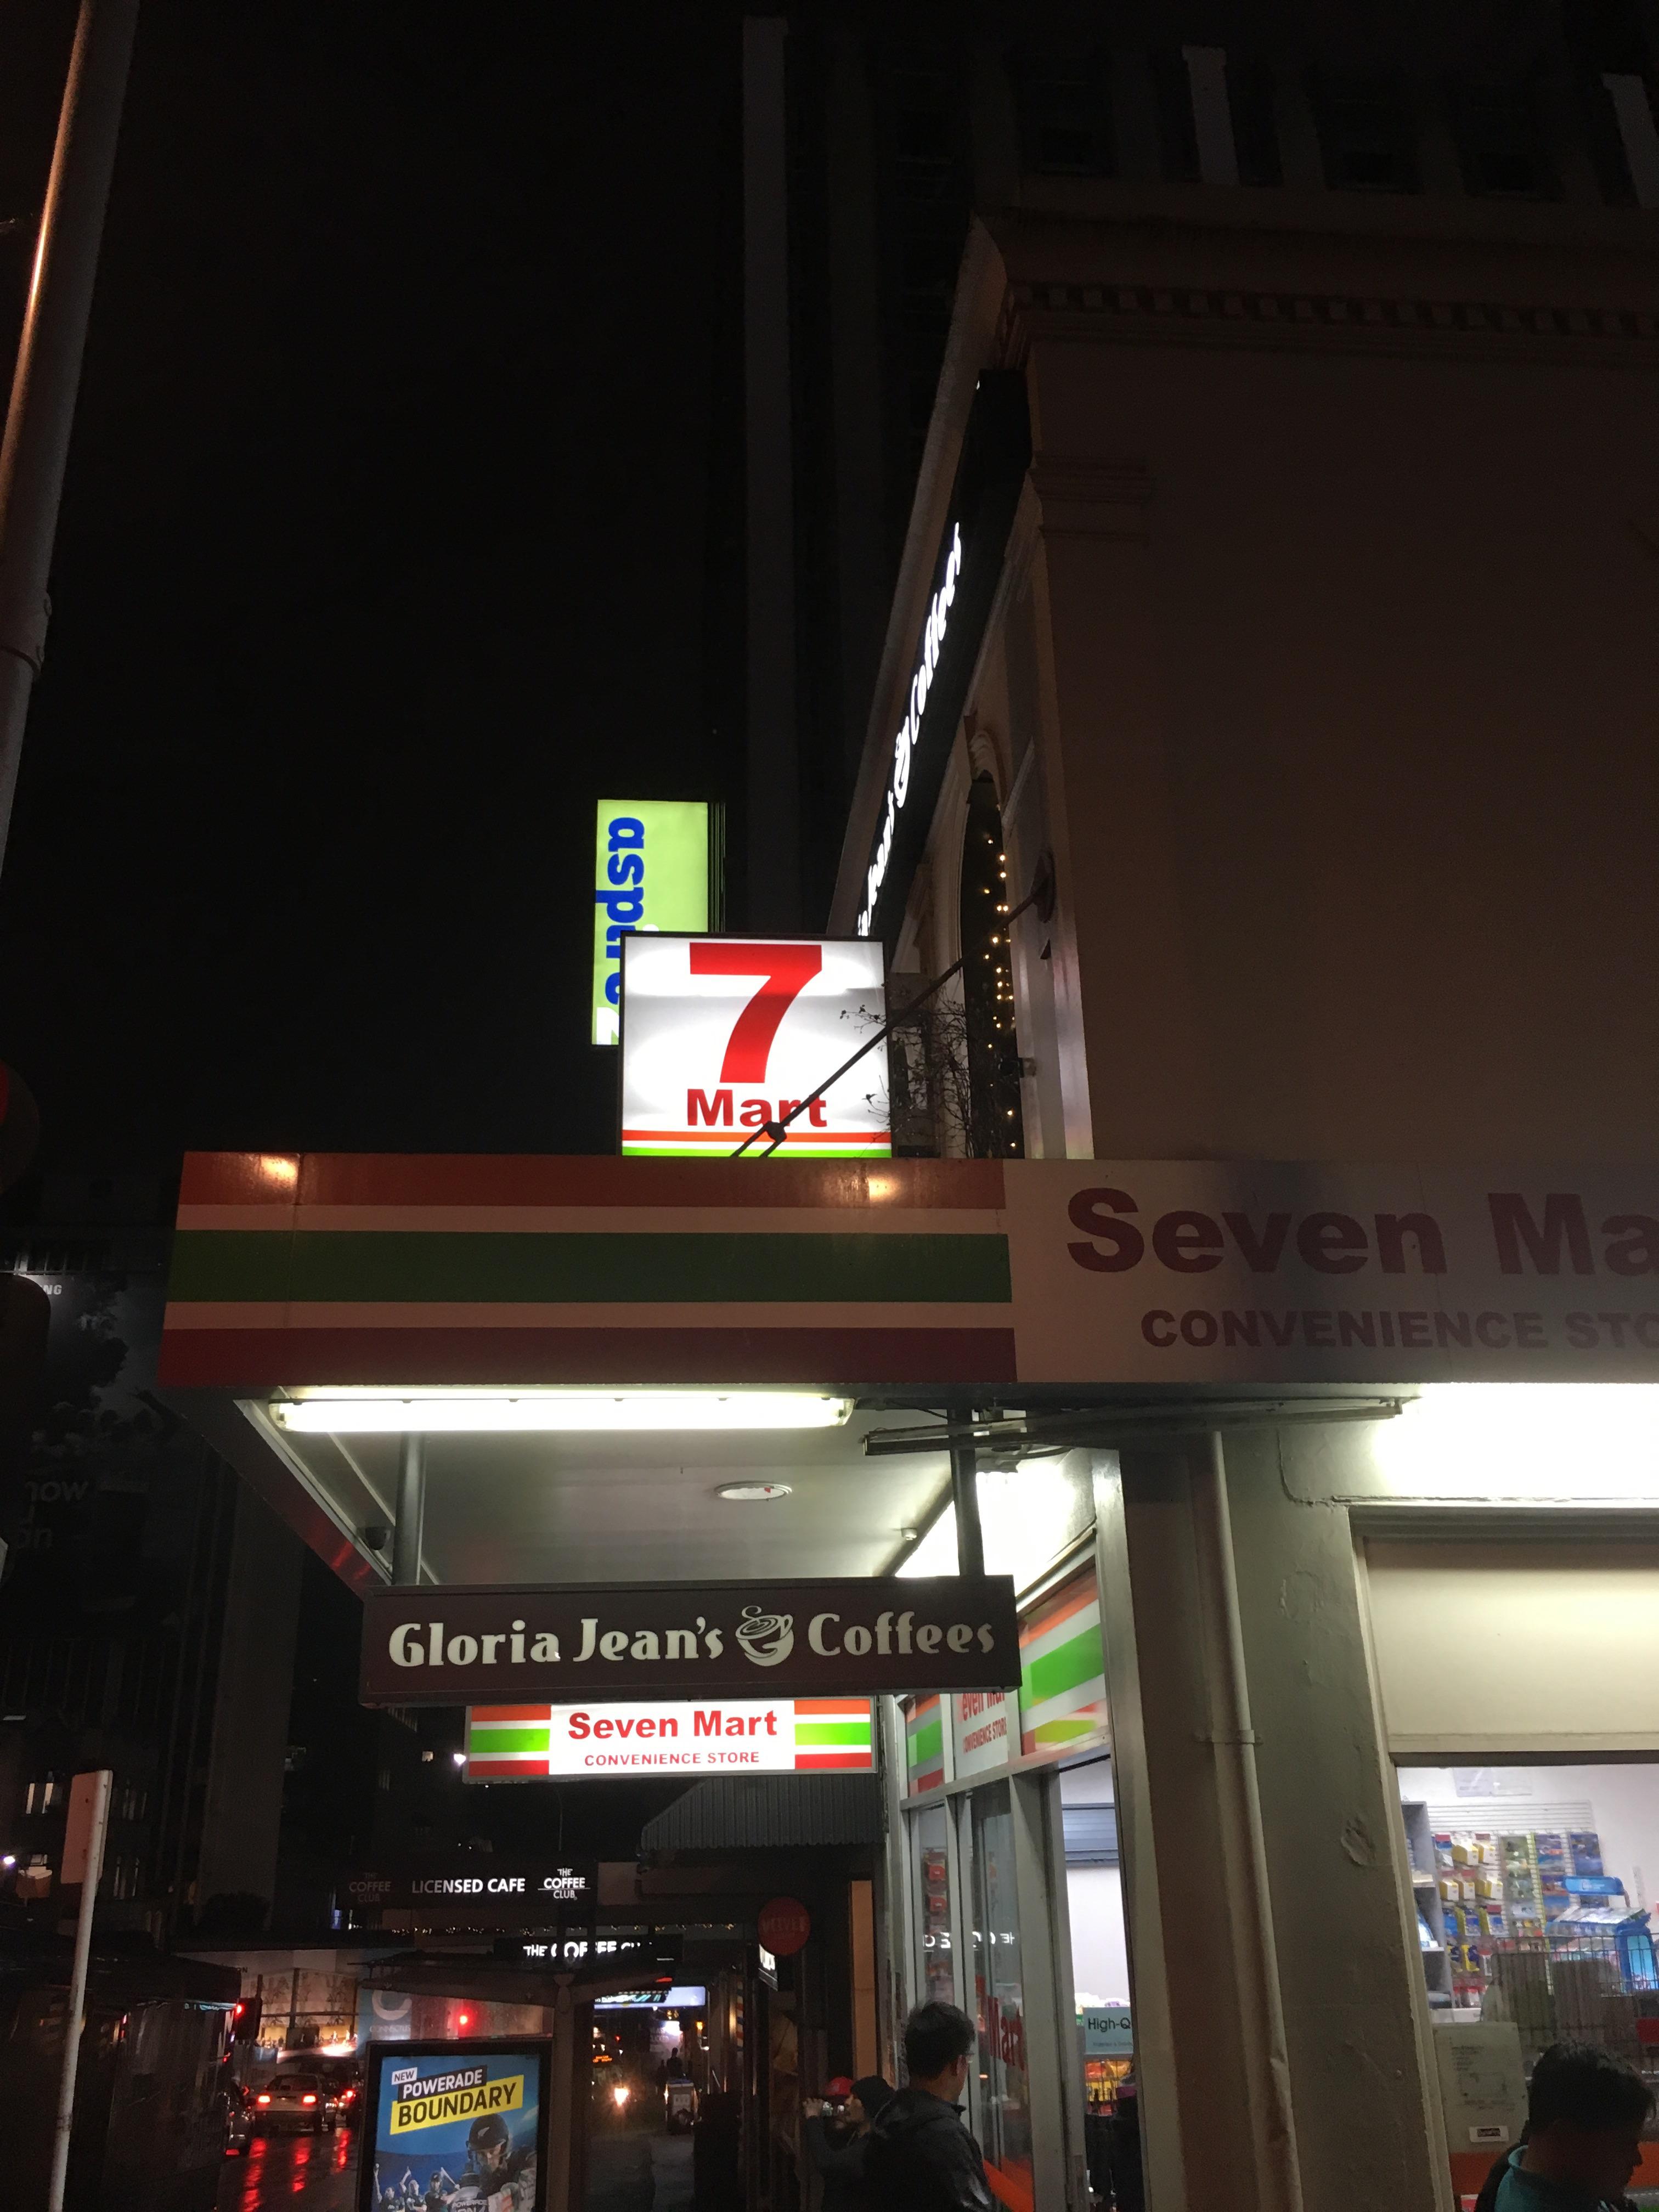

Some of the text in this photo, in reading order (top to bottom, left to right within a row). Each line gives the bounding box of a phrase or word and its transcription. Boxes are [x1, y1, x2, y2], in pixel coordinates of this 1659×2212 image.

[689, 942, 822, 1084] 7
[686, 1088, 827, 1127] Mart
[1066, 1187, 1659, 1276] Seven Ma
[1141, 1308, 1549, 1348] CONVENIENCE
[388, 1611, 995, 1667] Gloria Jean's Coffees
[568, 1710, 777, 1740] Seven Mart
[584, 1751, 760, 1767] CONVENIENCE STORE
[544, 1877, 586, 1889] COFFEE
[557, 1867, 573, 1877] THE
[348, 1881, 392, 1892] COFFEE
[411, 1878, 526, 1893] LICENSED CAFE
[553, 1889, 575, 1899] CLUB
[522, 1944, 548, 1957] THE
[394, 2070, 415, 2082] NEW
[403, 2068, 483, 2099] POWERADE
[398, 2082, 517, 2127] BOUNDARY
